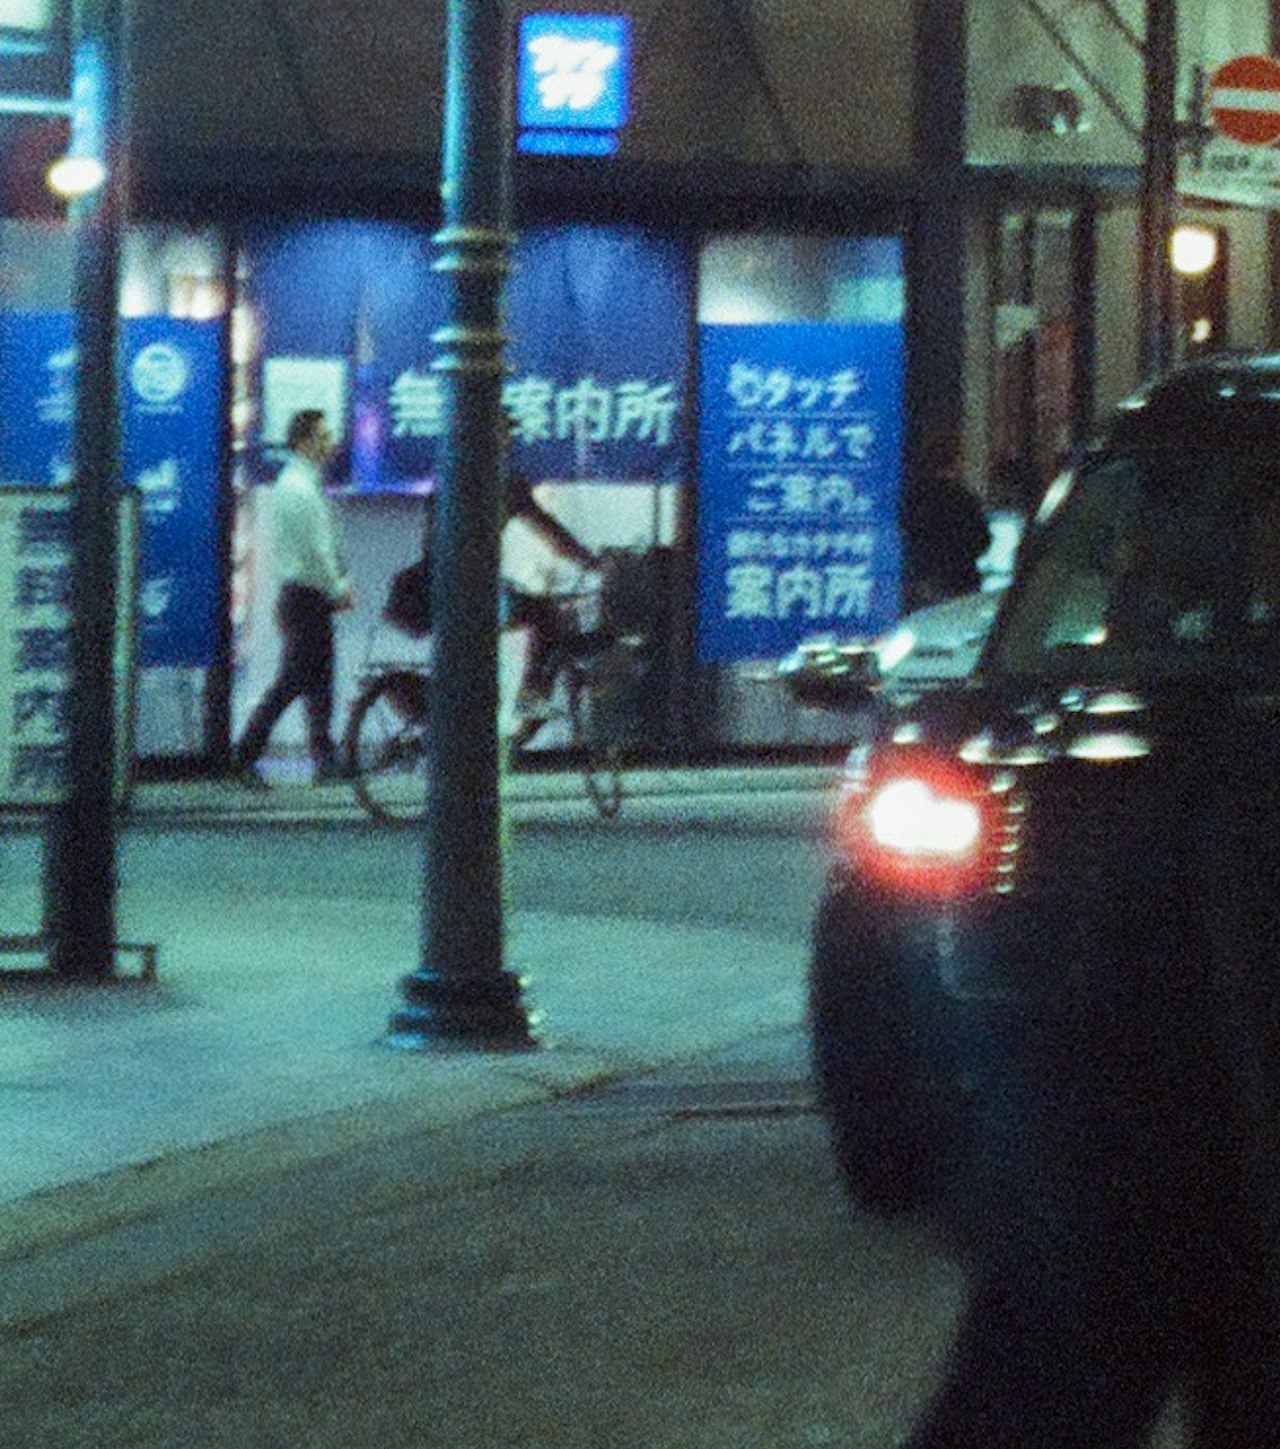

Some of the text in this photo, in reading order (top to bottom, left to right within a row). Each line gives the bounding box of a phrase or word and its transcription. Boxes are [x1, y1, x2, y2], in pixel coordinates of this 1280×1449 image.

[389, 368, 678, 445] 無案内所
[724, 562, 873, 618] 案内所
